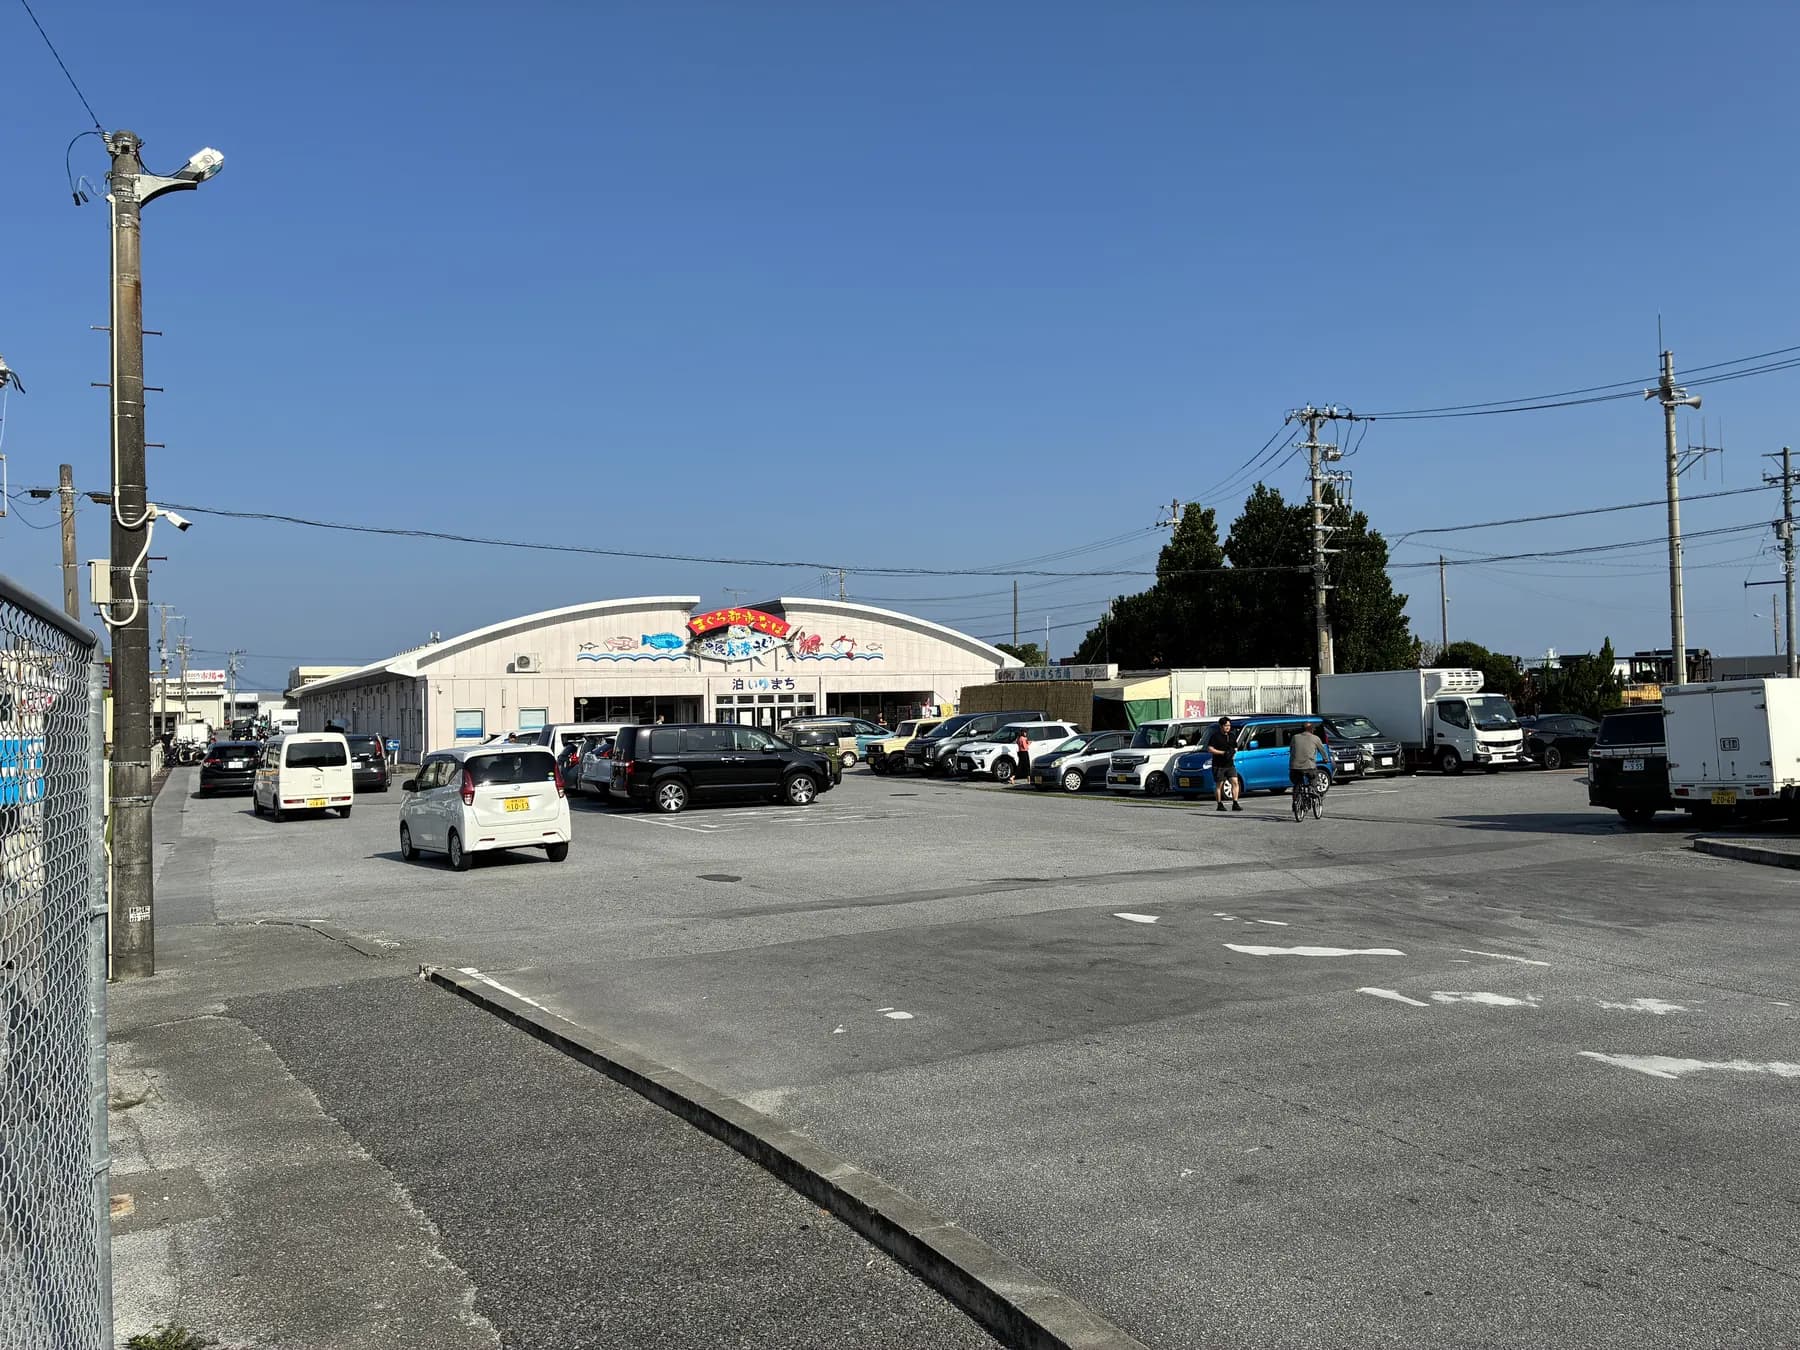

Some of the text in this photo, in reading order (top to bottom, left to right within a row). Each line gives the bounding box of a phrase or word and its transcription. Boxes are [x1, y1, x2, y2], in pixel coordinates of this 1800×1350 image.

[732, 677, 795, 691] 泊いゆまち
